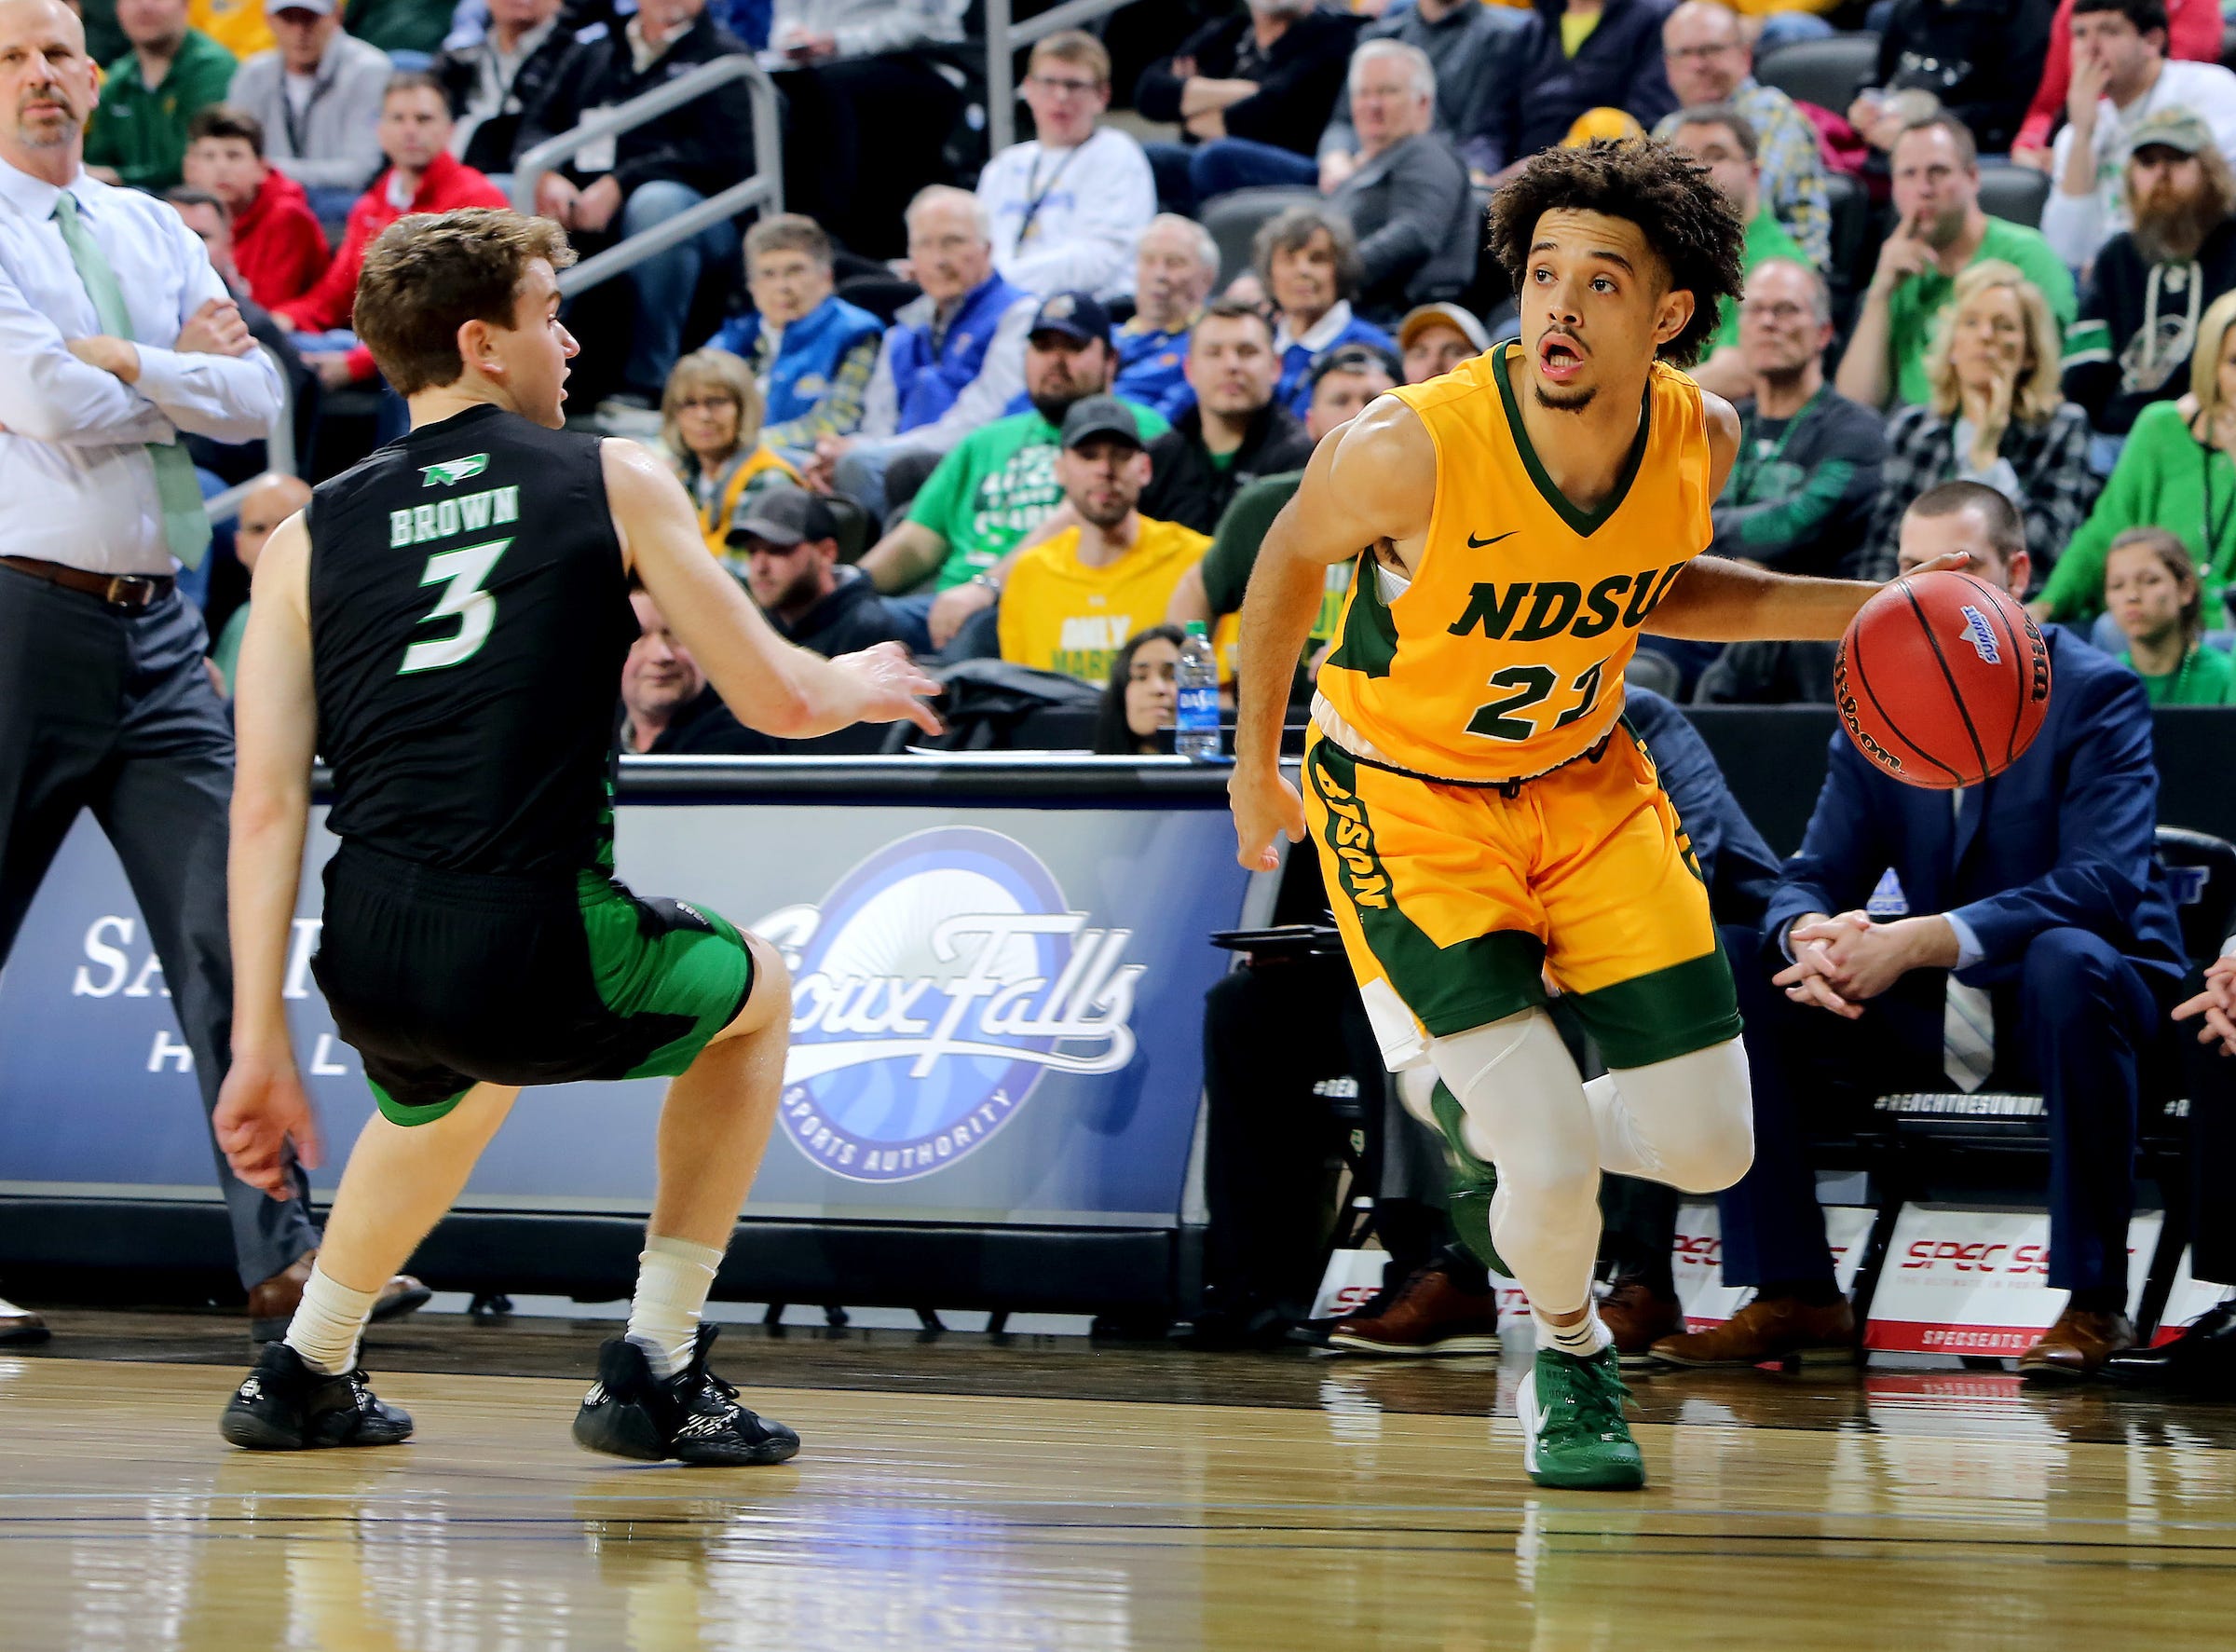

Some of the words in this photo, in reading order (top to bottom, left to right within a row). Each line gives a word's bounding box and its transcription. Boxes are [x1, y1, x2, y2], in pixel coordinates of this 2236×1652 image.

[389, 485, 520, 550] BROWN
[395, 537, 516, 676] 3
[1446, 559, 1687, 642] NDSU
[1833, 637, 1902, 770] Wilson
[1315, 762, 1389, 910] BISON
[909, 910, 1148, 1079] Falls
[784, 1086, 857, 1165] SPORTS
[863, 1087, 1012, 1172] AUTHORITY
[1874, 1093, 2049, 1116] #REACHTHESUMMI
[1900, 1240, 2008, 1273] SPEC
